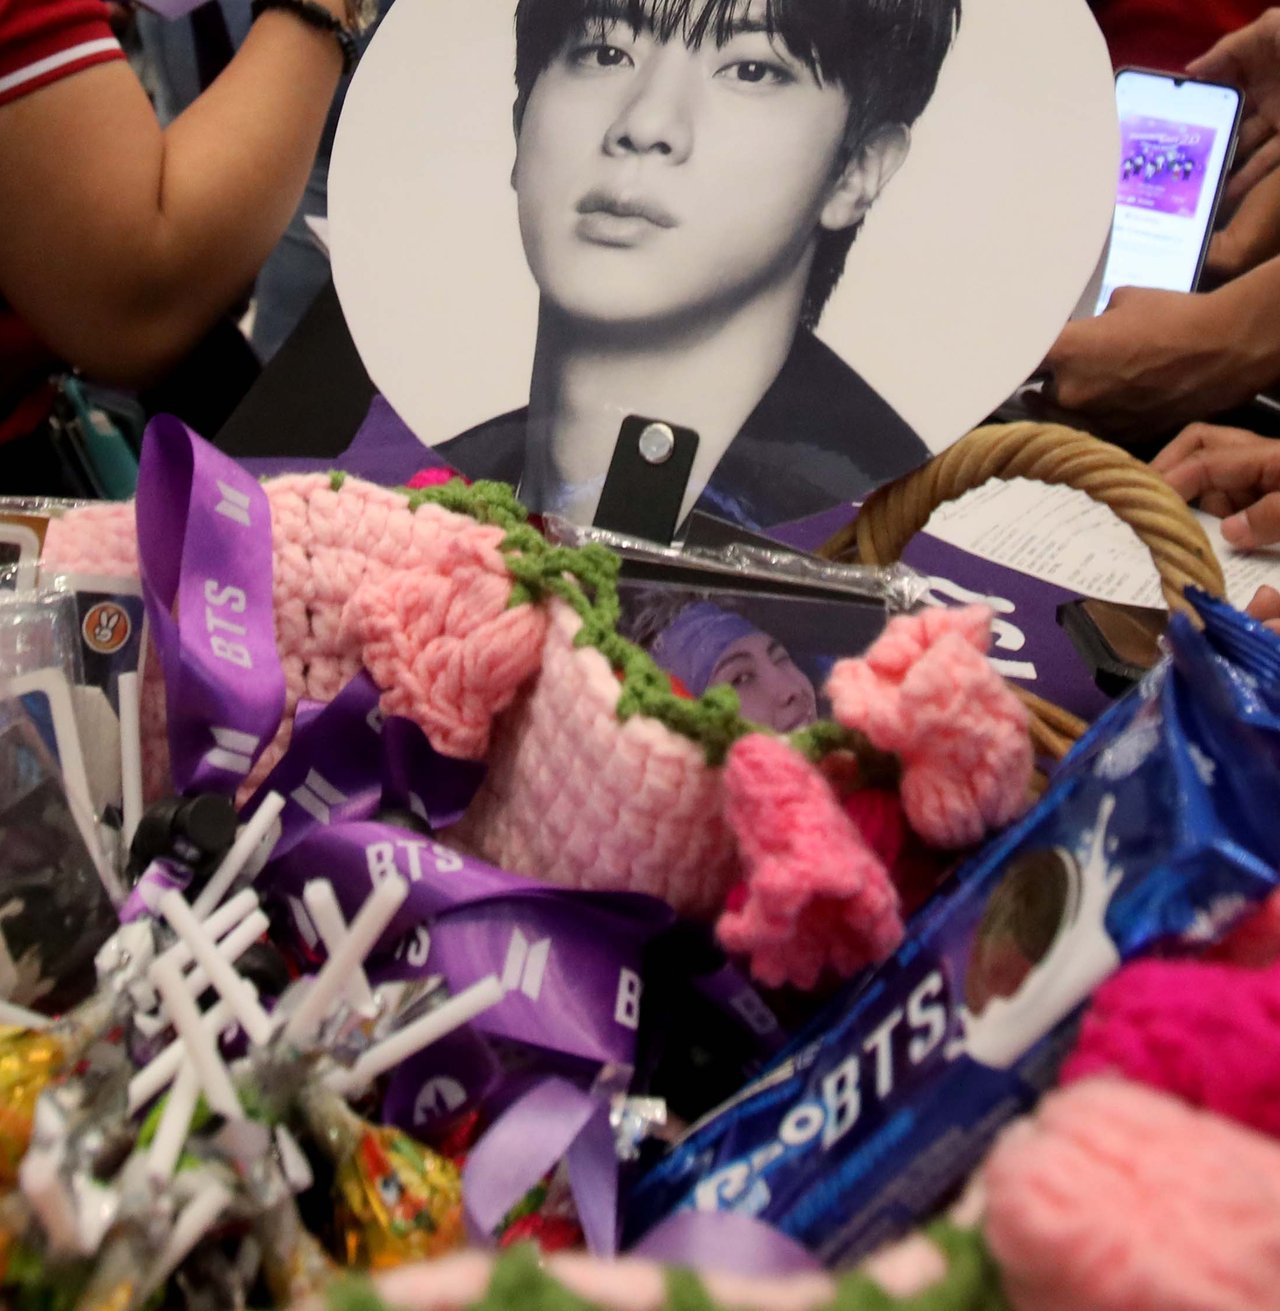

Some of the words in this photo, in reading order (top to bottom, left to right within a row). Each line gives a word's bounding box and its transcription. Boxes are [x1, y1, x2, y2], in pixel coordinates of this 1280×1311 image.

[203, 579, 253, 670] BTS
[366, 839, 464, 887] BTS
[821, 971, 947, 1150] BTS
